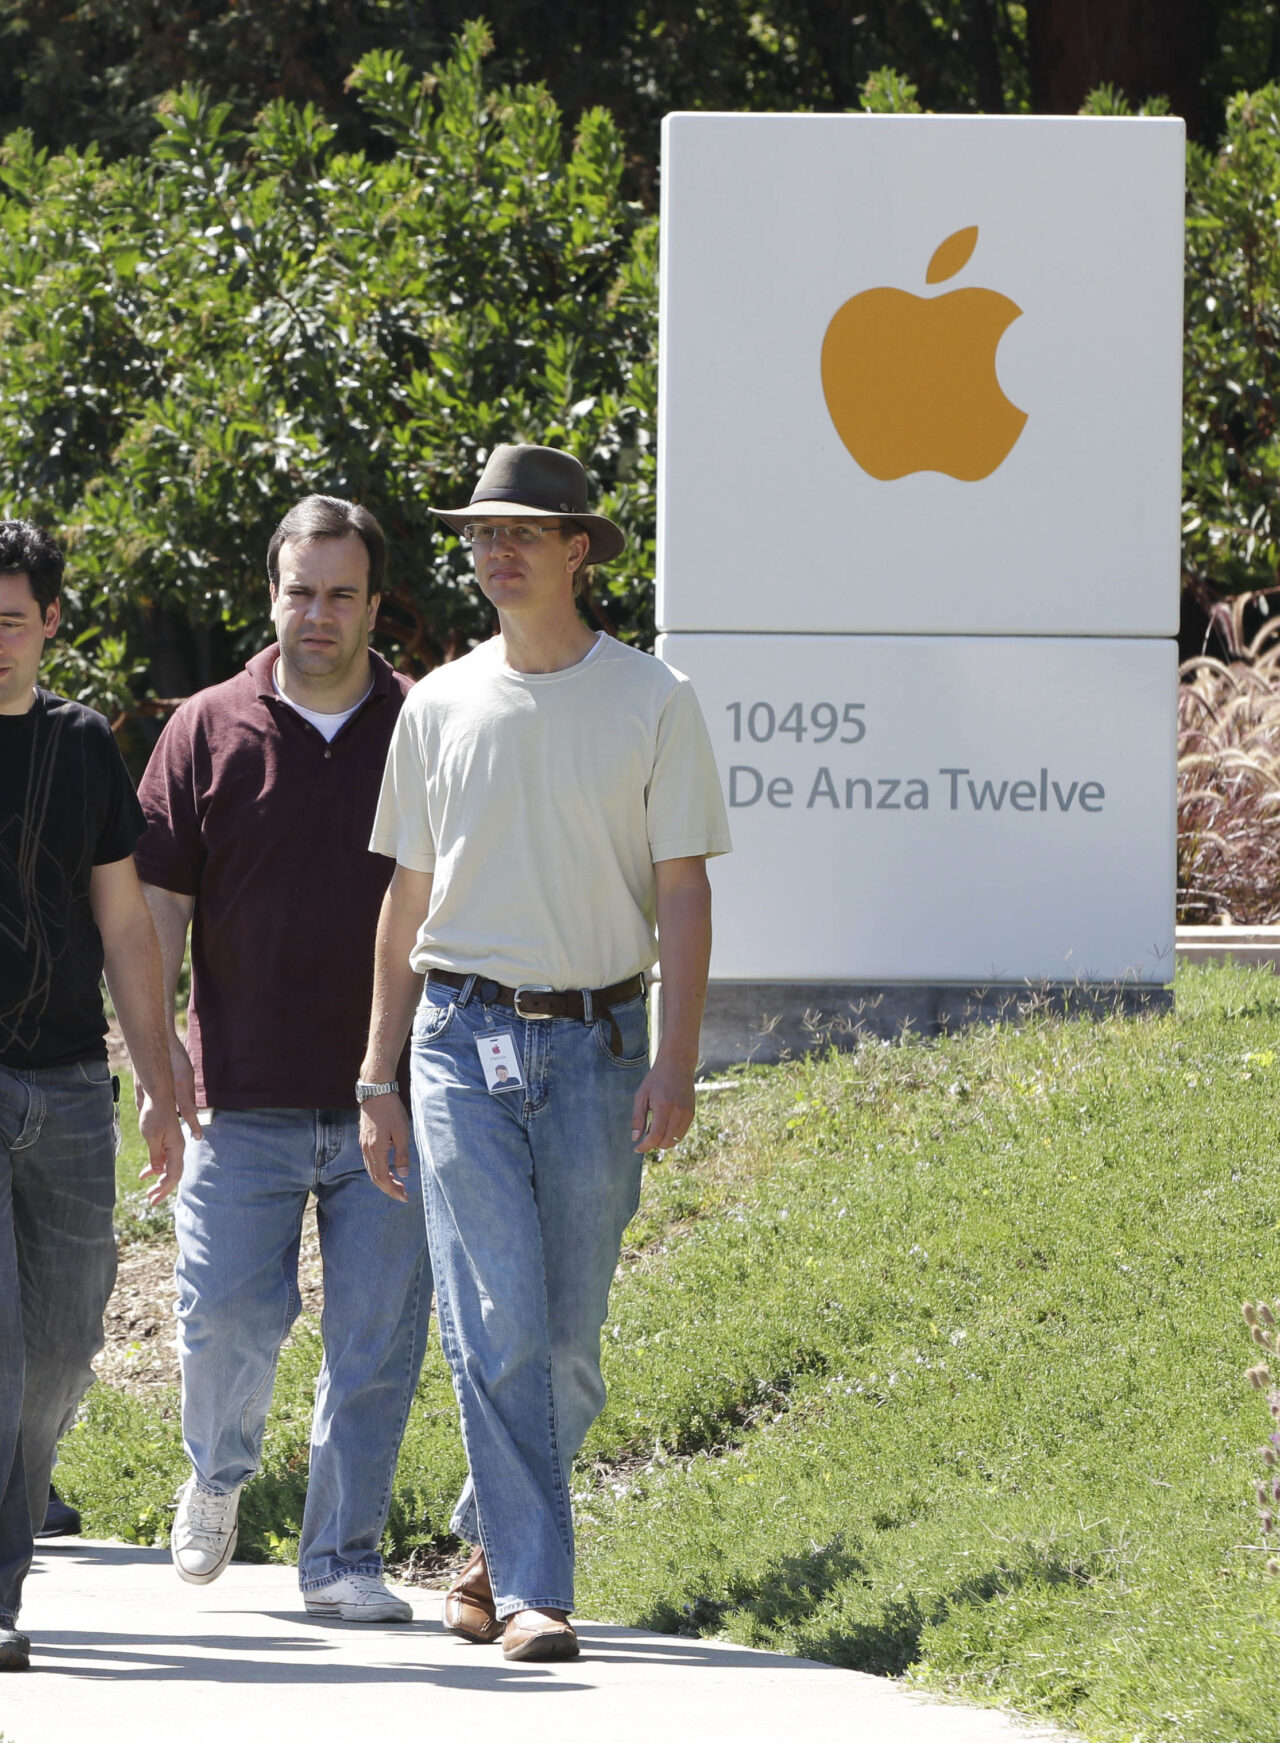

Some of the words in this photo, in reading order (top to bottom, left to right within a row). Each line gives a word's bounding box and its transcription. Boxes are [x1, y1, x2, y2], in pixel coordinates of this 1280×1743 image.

[726, 701, 866, 744] 10495
[729, 765, 794, 809] De
[806, 766, 929, 811] Anza
[938, 767, 1106, 813] Twelve
